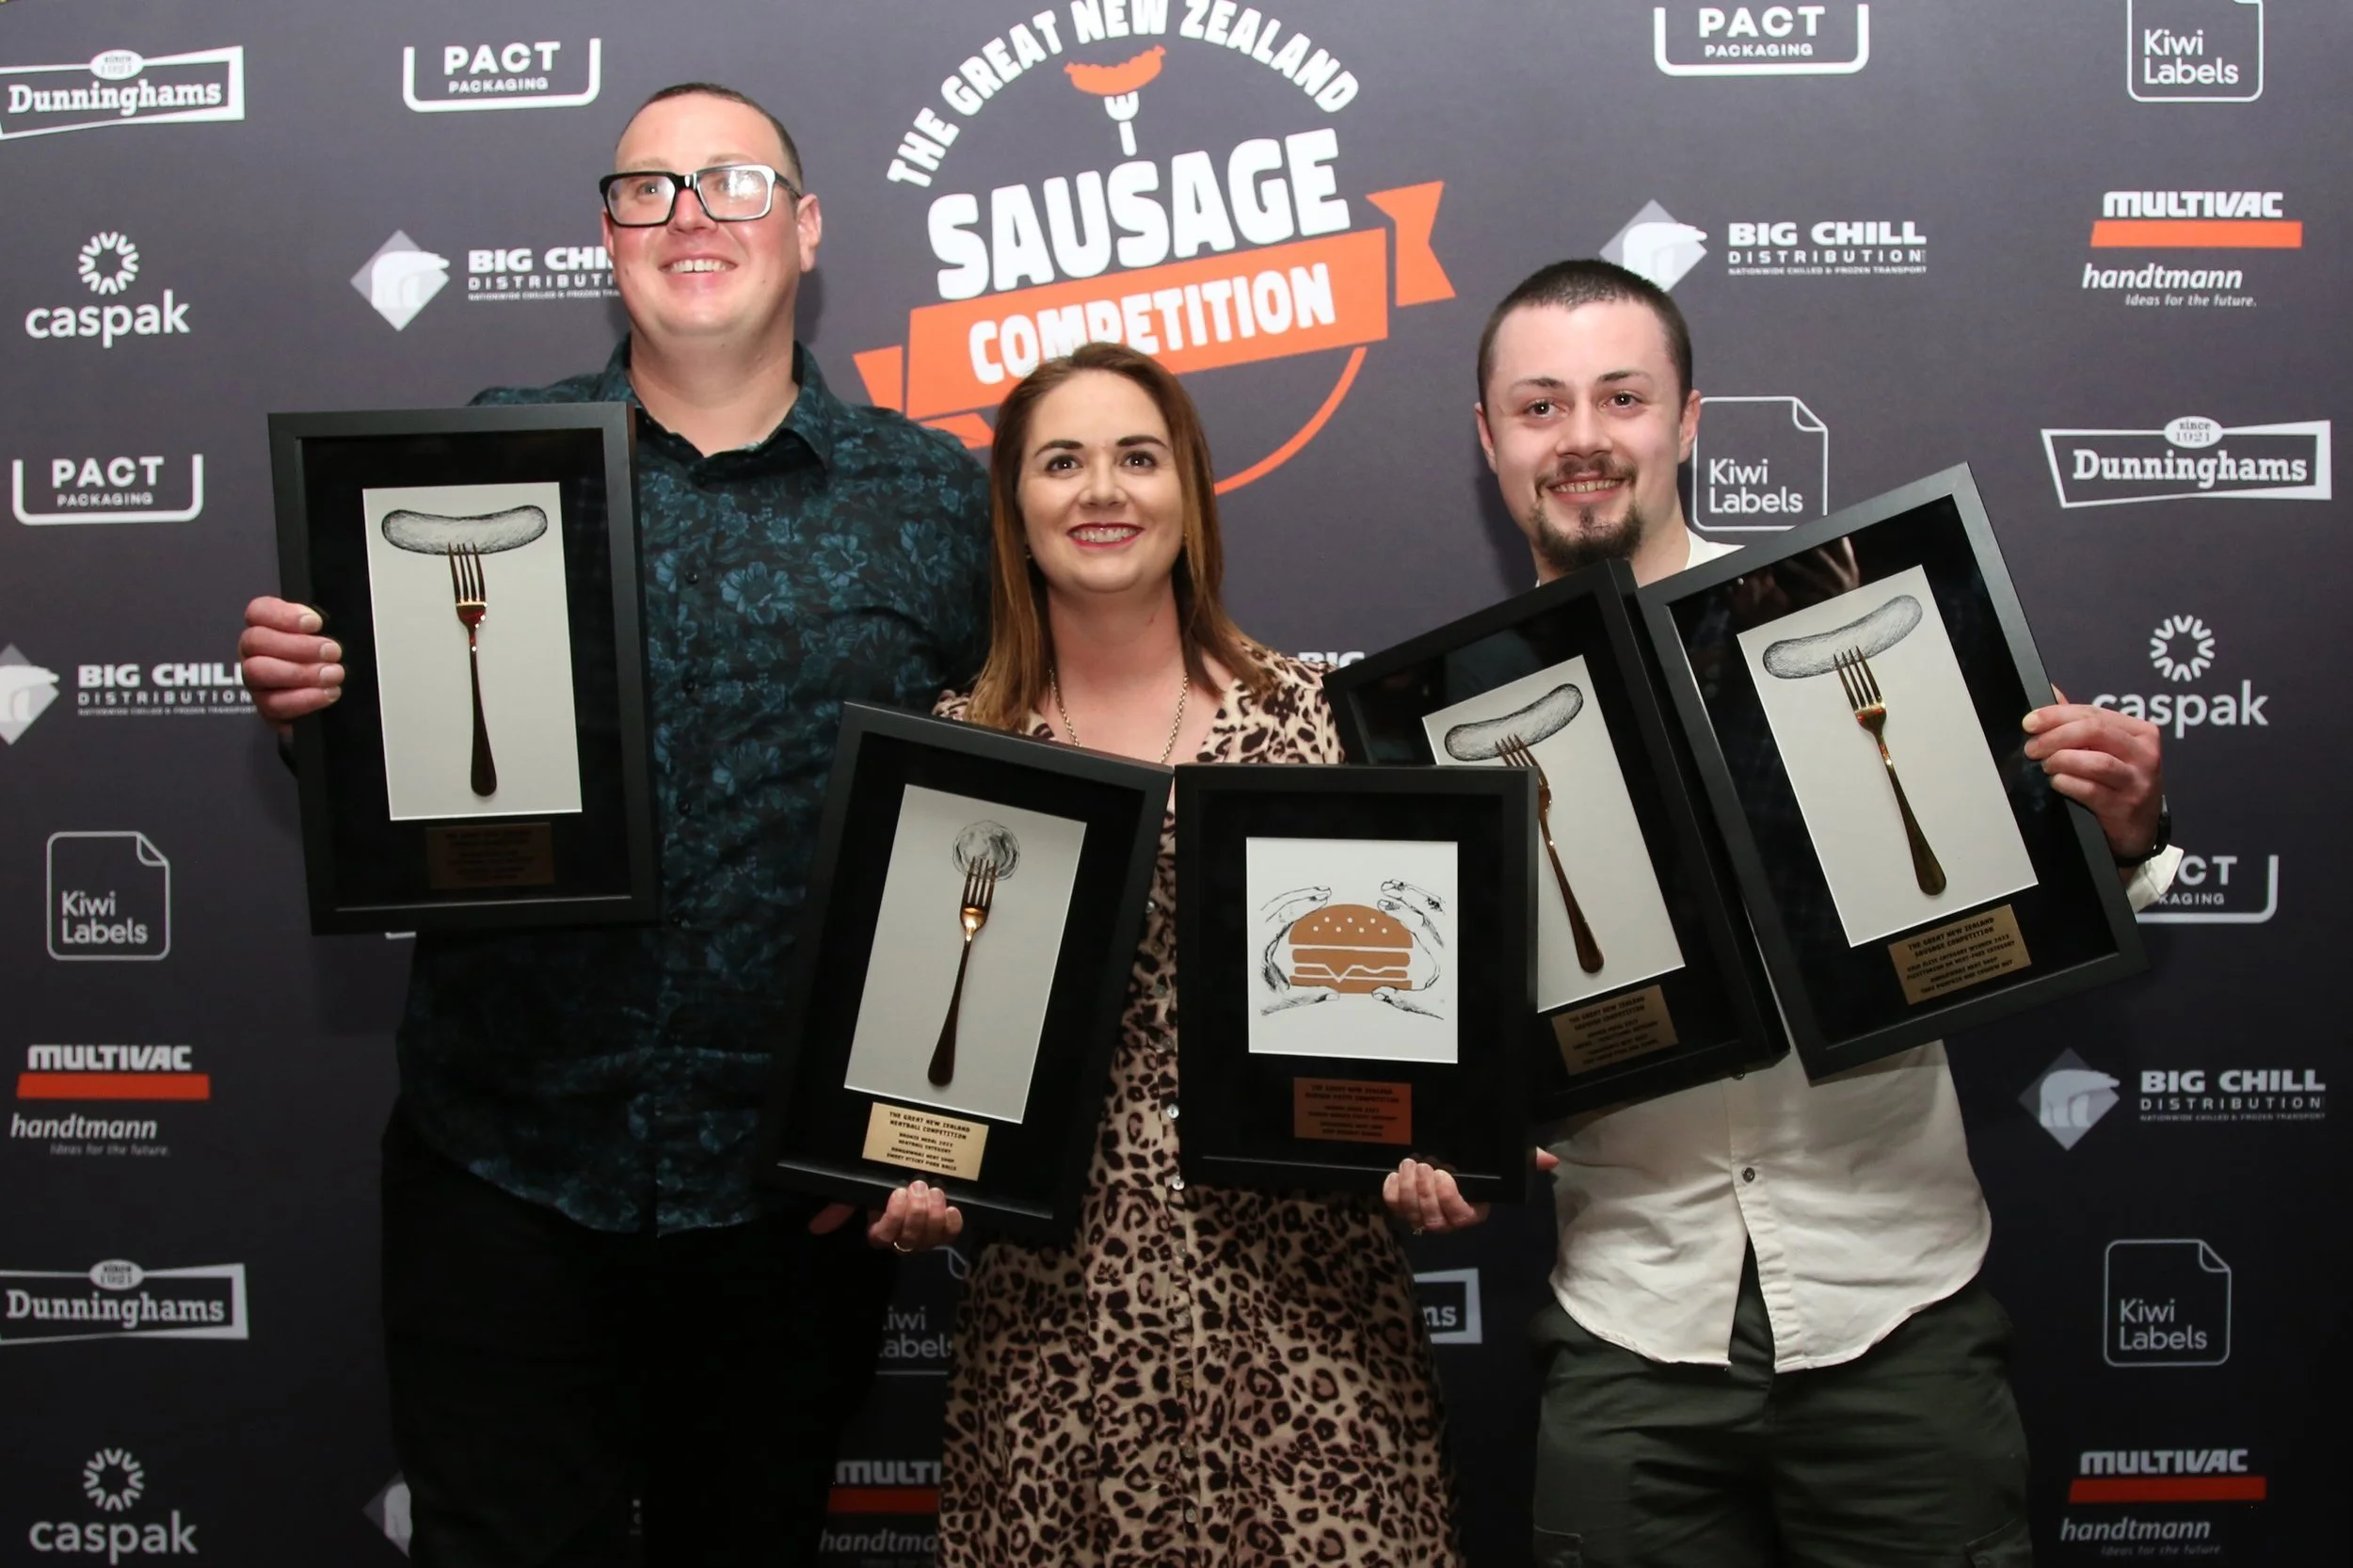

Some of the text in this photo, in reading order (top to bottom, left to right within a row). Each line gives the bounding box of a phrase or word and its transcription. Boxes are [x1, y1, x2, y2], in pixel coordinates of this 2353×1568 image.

[1697, 5, 1826, 39] PACT
[1704, 42, 1814, 57] PACKAGING
[2143, 29, 2203, 56] Kiwi
[443, 41, 561, 75] PACT
[2143, 57, 2239, 85] Labels
[8, 79, 222, 117] Dunninghams
[448, 77, 549, 93] PACKAGING
[887, 0, 1359, 188] THE GREAT NEW ZEALAND
[927, 128, 1351, 300] SAUSAGE
[2103, 191, 2283, 217] MULTIVAC
[1728, 221, 1927, 247] BIG CHILL
[468, 247, 613, 273] BIG CHI
[1728, 249, 1922, 264] DISTRIBUTION
[468, 273, 613, 291] DISTRIBUTI
[1728, 267, 1785, 276] NATIONWIDE
[1786, 266, 1824, 275] CHILLED
[1873, 265, 1927, 274] TRANSPORT
[2082, 263, 2243, 289] handtmann
[2125, 294, 2161, 307] Ideas
[2165, 294, 2184, 306] for
[2187, 294, 2210, 307] the
[24, 289, 190, 348] caspak
[968, 263, 1336, 385] COMPETITION
[52, 456, 164, 488] PACT
[1708, 458, 1769, 485] Kiwi
[2073, 449, 2308, 488] Dunninghams
[56, 492, 153, 507] PACKAGING
[1708, 487, 1803, 514] Labels
[77, 664, 140, 688] BIG
[61, 890, 116, 917] Kiwi
[61, 919, 148, 945] Labels
[27, 1045, 192, 1071] MULTIVAC
[2140, 1069, 2327, 1093] BIG CHILL
[2140, 1096, 2321, 1111] DISTRIBUTION
[10, 1112, 158, 1139] handtmann
[889, 1120, 966, 1139] MEATBALL COMPETITION
[903, 1114, 922, 1123] GREAT
[942, 1123, 970, 1132] ZEALAND
[6, 1289, 224, 1329] Dunninghams
[2119, 1298, 2175, 1322] Kiwi
[2119, 1325, 2208, 1351] Labels
[836, 1460, 941, 1485] MULTI
[2080, 1449, 2249, 1475] MULTIVAC
[29, 1511, 198, 1564] caspak
[819, 1527, 939, 1553] handtma
[2059, 1517, 2211, 1542] handtmann
